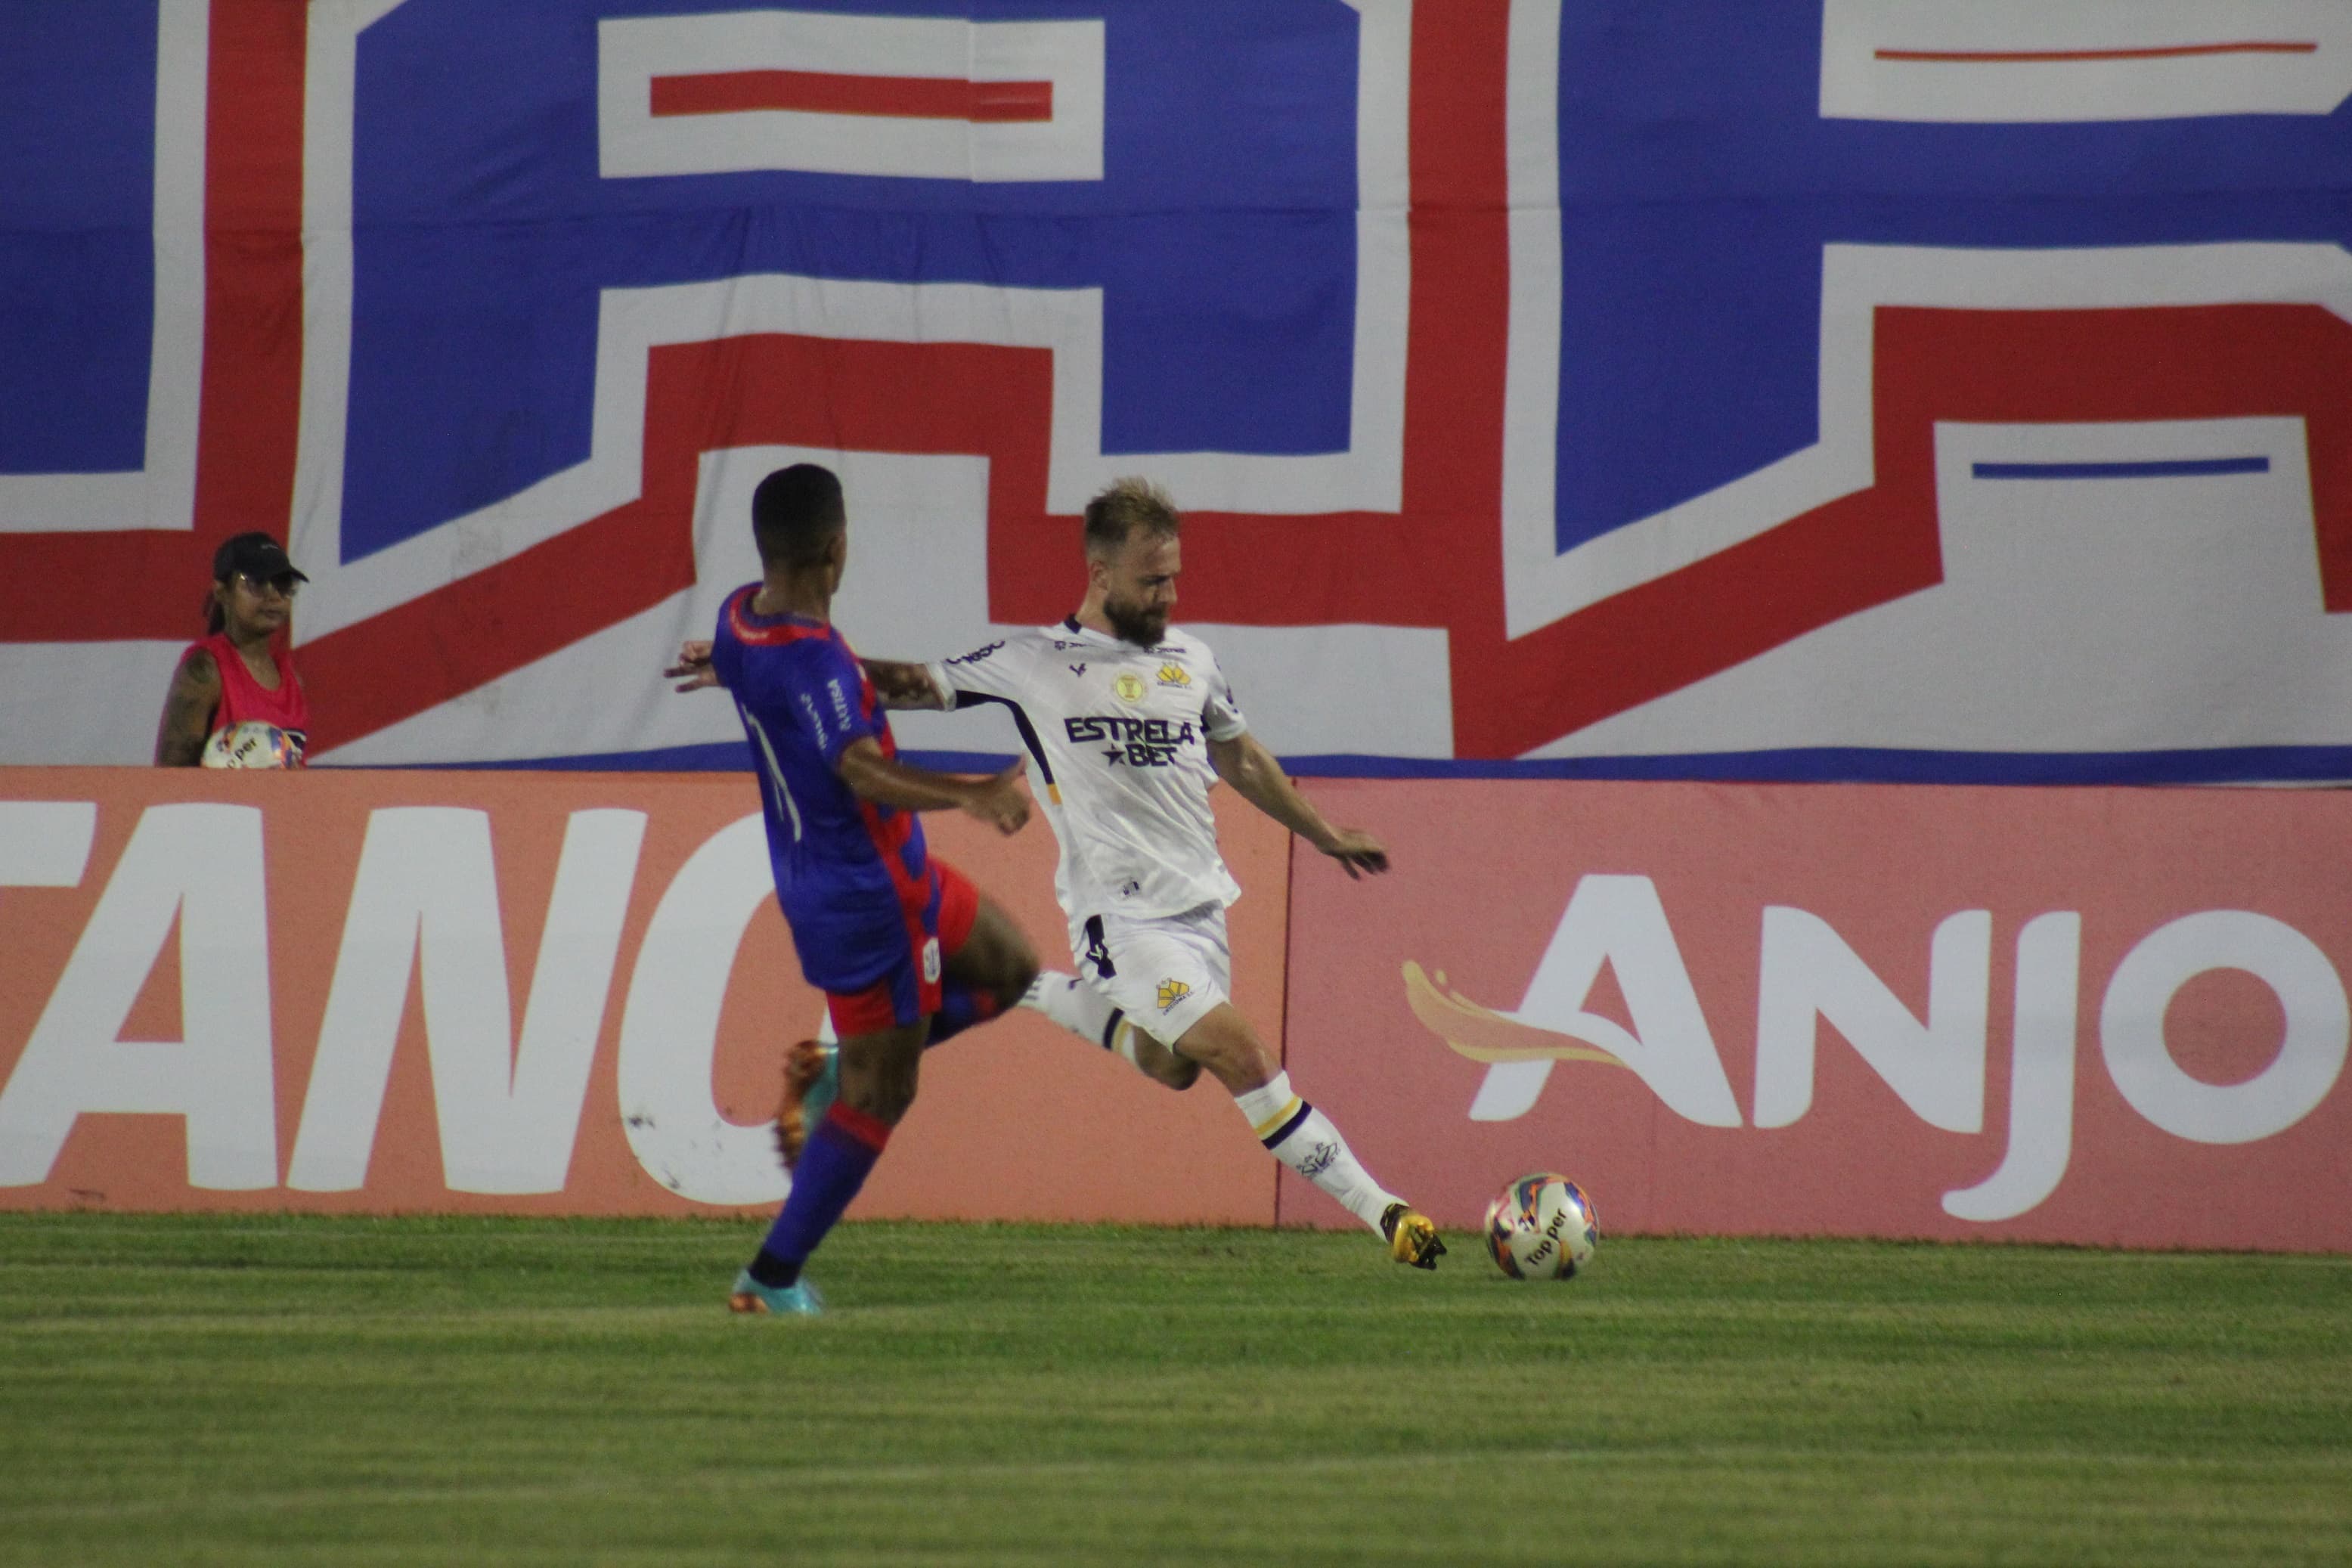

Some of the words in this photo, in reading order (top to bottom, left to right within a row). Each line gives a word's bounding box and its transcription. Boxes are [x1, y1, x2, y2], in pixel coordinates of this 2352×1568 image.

[1064, 717, 1195, 745] ESTRELA
[1125, 743, 1177, 767] BET
[1468, 873, 2350, 1222] ANJO
